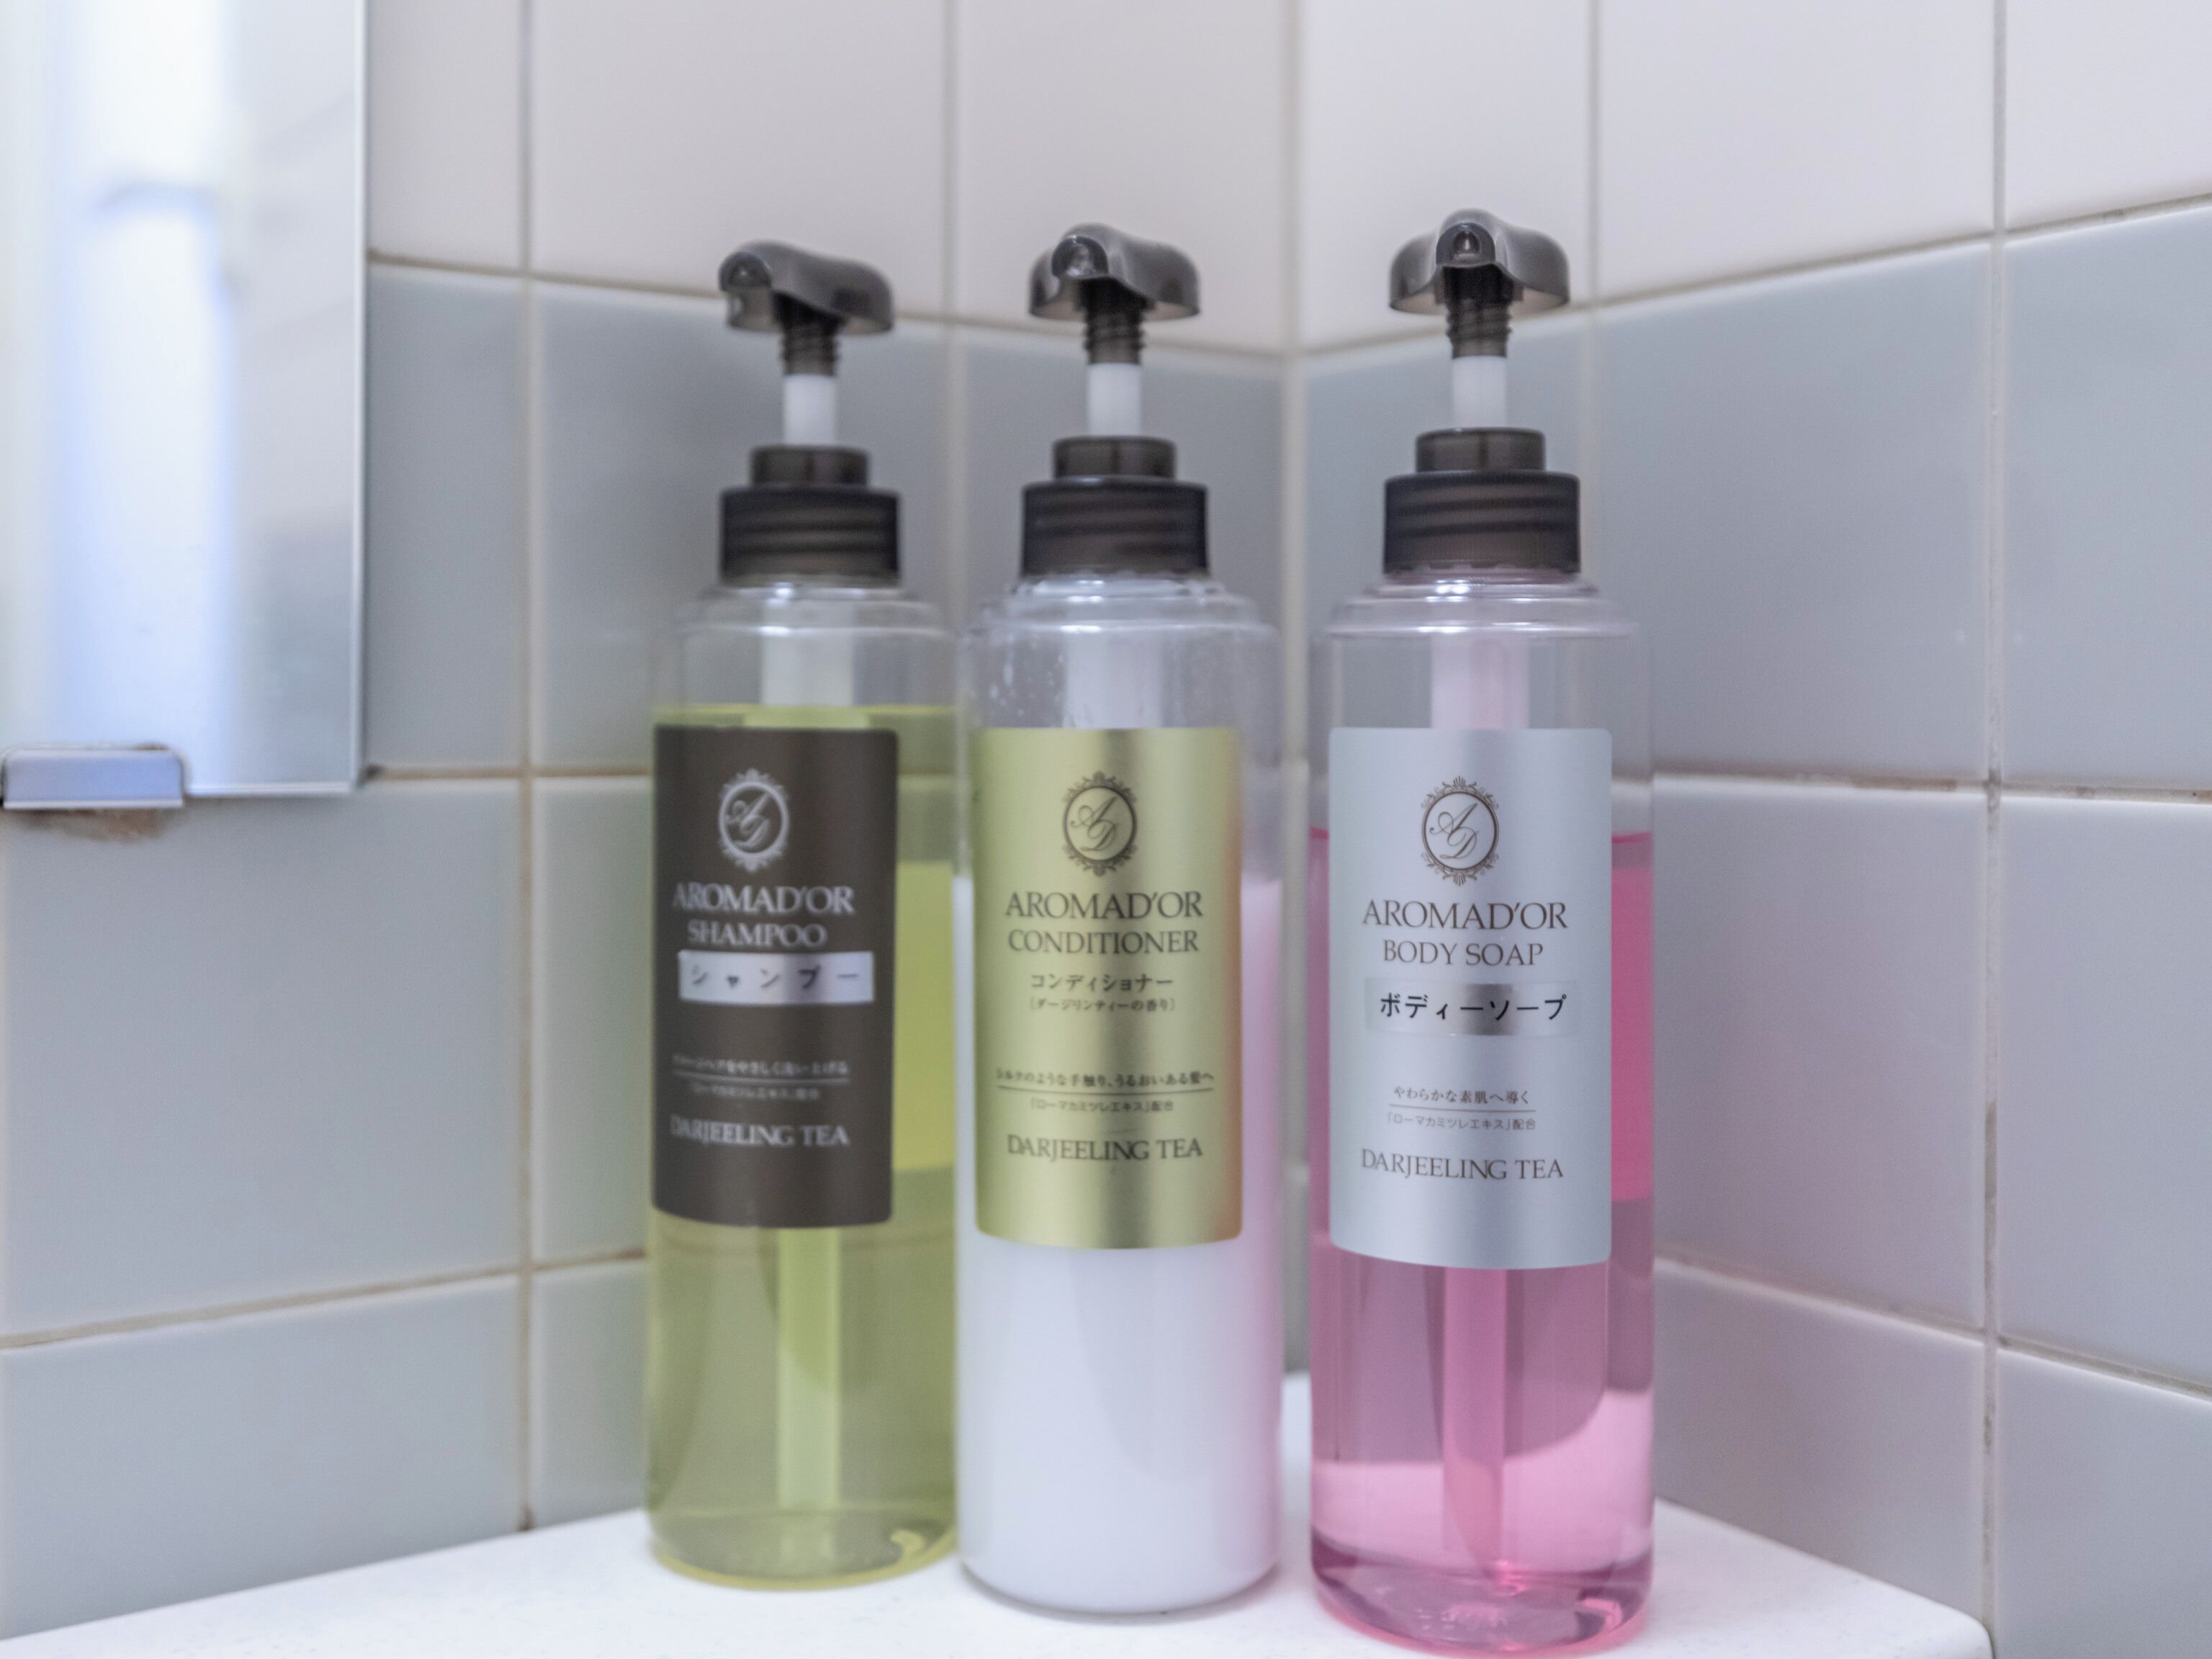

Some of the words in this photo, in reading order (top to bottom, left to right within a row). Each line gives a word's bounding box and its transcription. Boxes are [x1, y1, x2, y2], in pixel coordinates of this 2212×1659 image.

[673, 881, 855, 914] AROMAD'OR
[1006, 891, 1203, 920] AROMAD'OR
[1362, 899, 1568, 930] AROMAD'OR
[687, 919, 828, 948] SHAMPOO
[1008, 929, 1200, 955] CONDITIONER
[1383, 940, 1458, 965] BODY
[1465, 943, 1544, 966] SOAP
[691, 963, 860, 989] シャンプー
[1030, 973, 1174, 993] コンディショナー
[1380, 992, 1567, 1021] ボディーソープ
[1393, 1086, 1530, 1105] やわらかな素肌へ導く
[670, 1115, 795, 1146] DARJEELING
[801, 1124, 850, 1146] TEA
[1388, 1112, 1537, 1130] 「ローマカミツレエキス」配合
[1007, 1133, 1149, 1162] DARJEELING
[1156, 1138, 1202, 1159] TEA
[1361, 1148, 1507, 1180] DARJEELING
[1515, 1159, 1564, 1179] TEA
